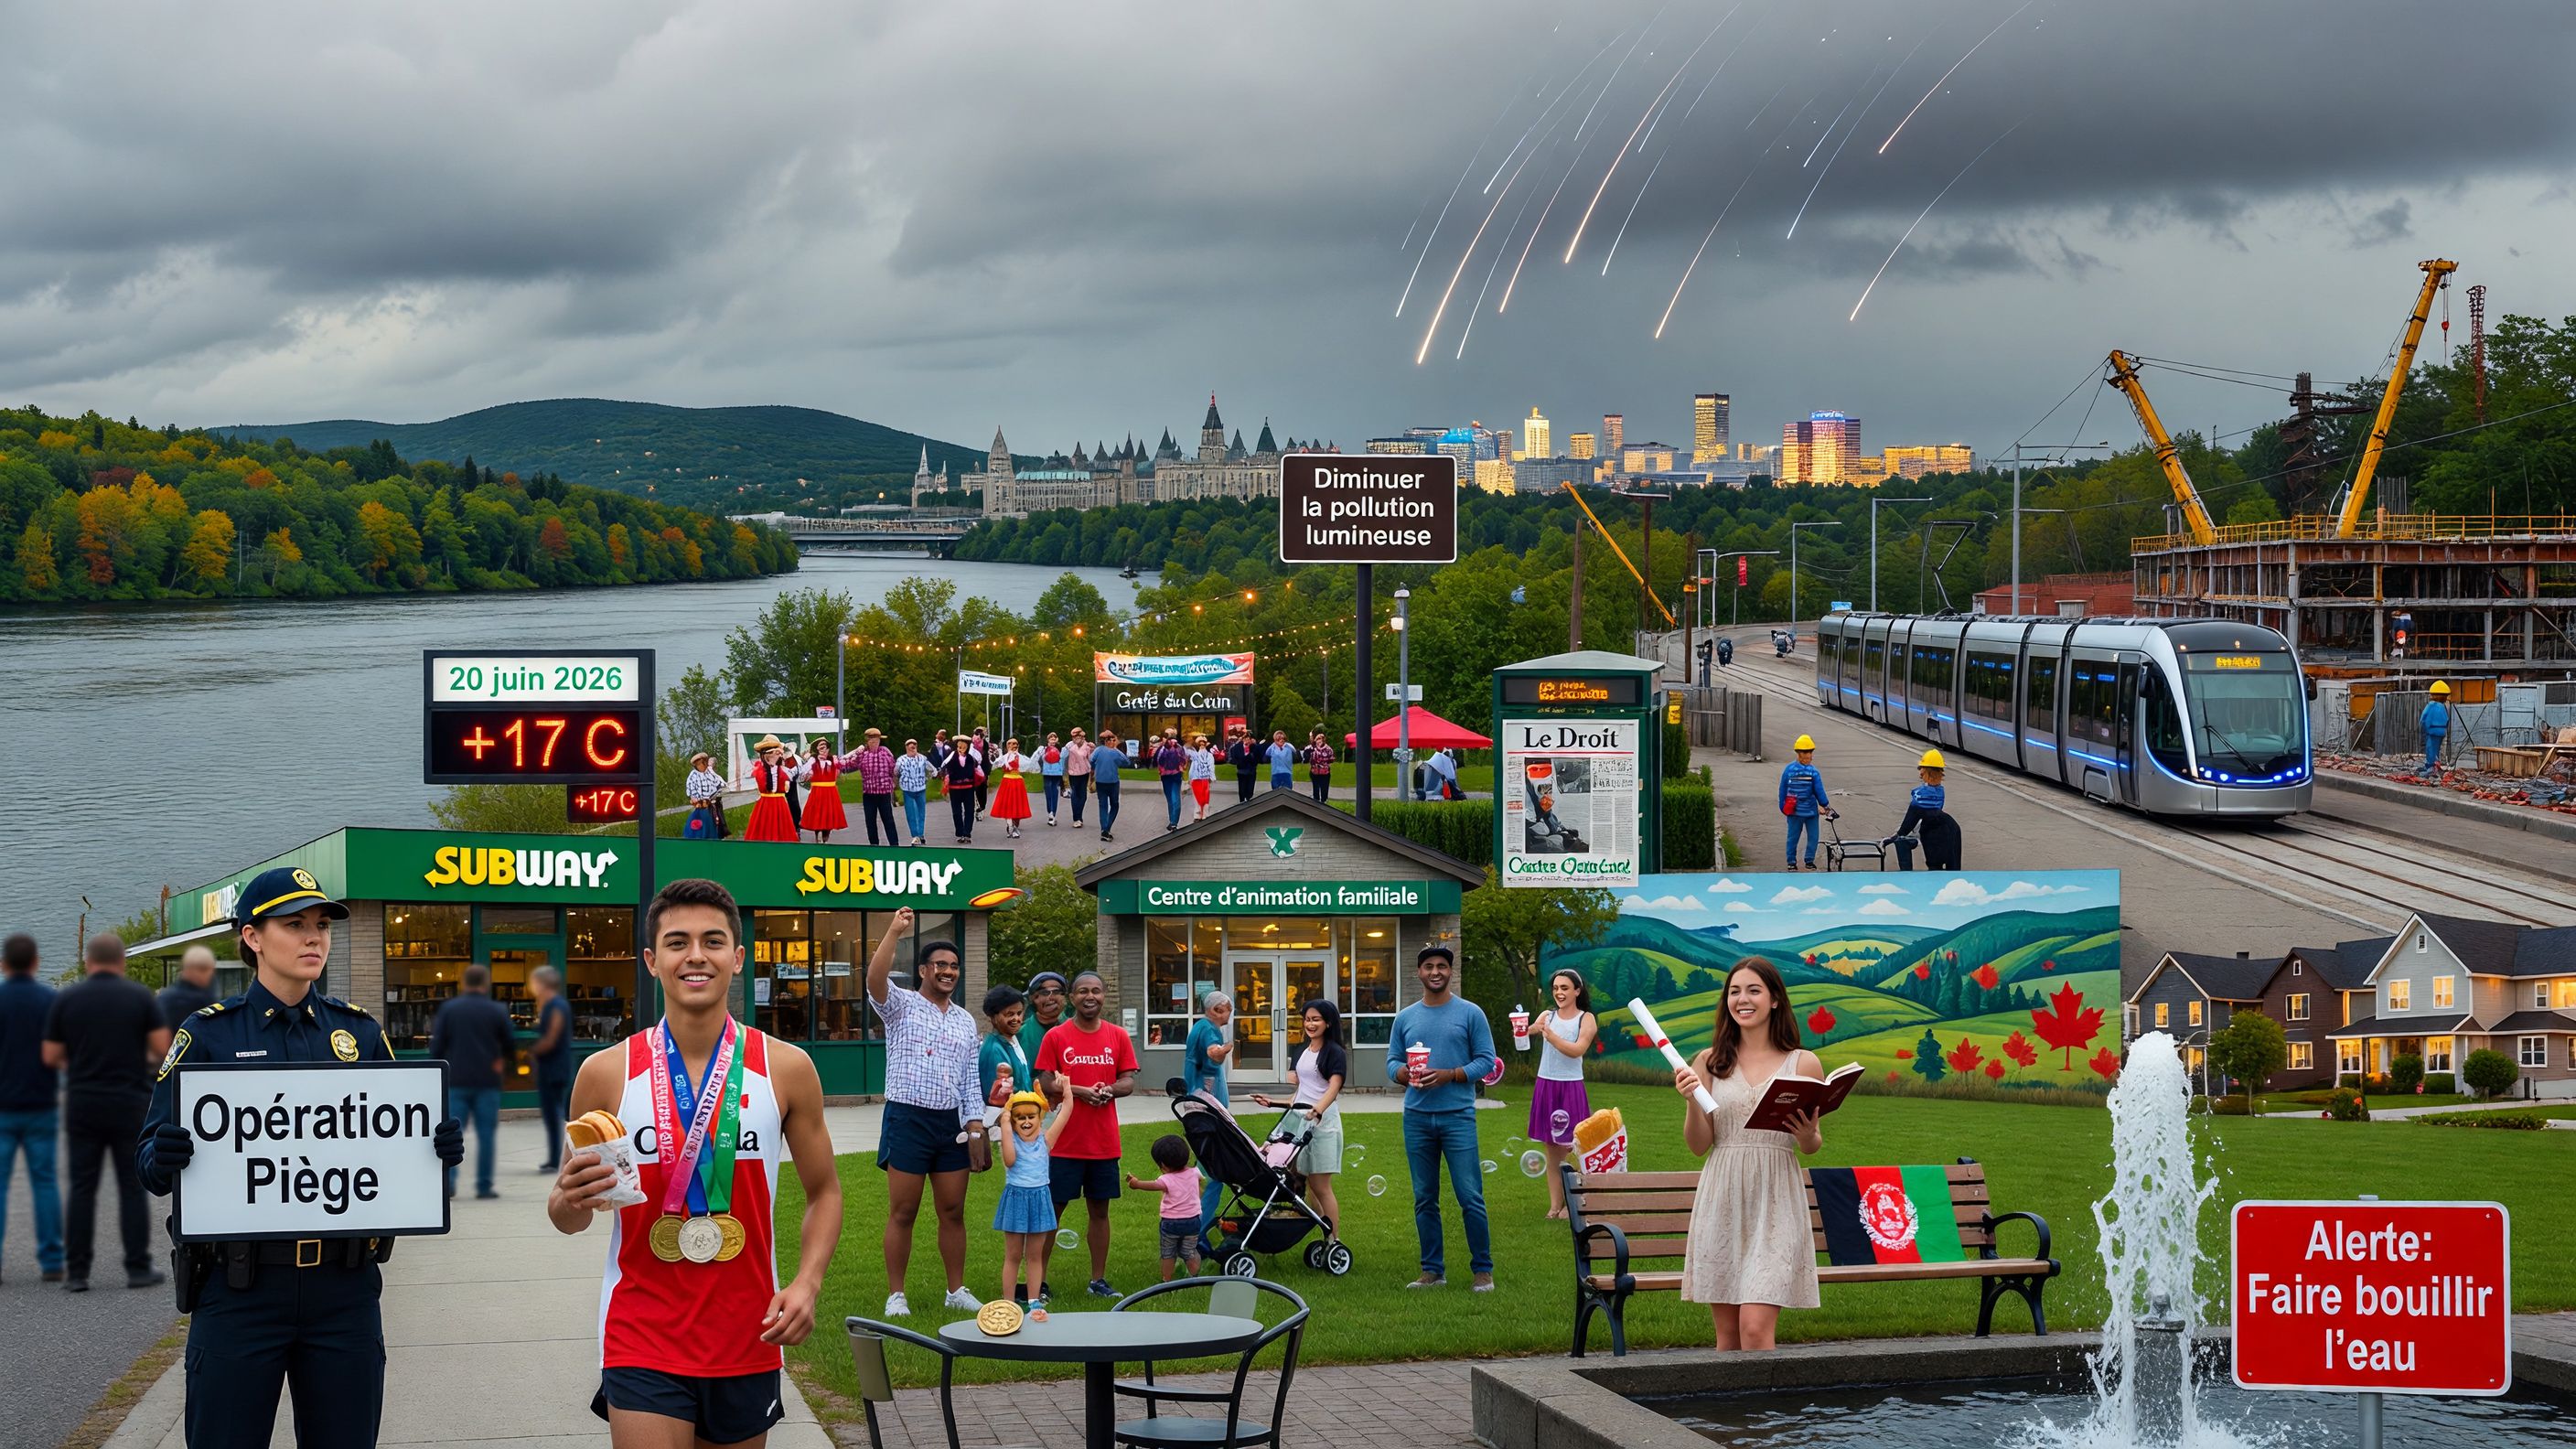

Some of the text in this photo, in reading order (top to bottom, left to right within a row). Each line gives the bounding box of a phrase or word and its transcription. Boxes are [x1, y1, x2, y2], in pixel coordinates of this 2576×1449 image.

[1315, 467, 1425, 489] Diminuer
[1303, 496, 1434, 522] la pollution
[1306, 524, 1432, 546] lumineuse
[449, 666, 622, 698] 20 juin 2026
[463, 719, 625, 767] +17 C
[1524, 727, 1619, 748] Le Droit
[574, 790, 635, 812] +17 C
[424, 846, 619, 888] SUBWAY
[795, 856, 963, 896] SUBWAY
[1148, 886, 1419, 906] Centre d'animation familiale
[192, 1091, 431, 1154] Opération
[246, 1155, 380, 1216] Piège
[2304, 1219, 2432, 1261] Alerte:
[2249, 1272, 2494, 1317] Faire bouillir
[2325, 1328, 2417, 1371] l'eau
